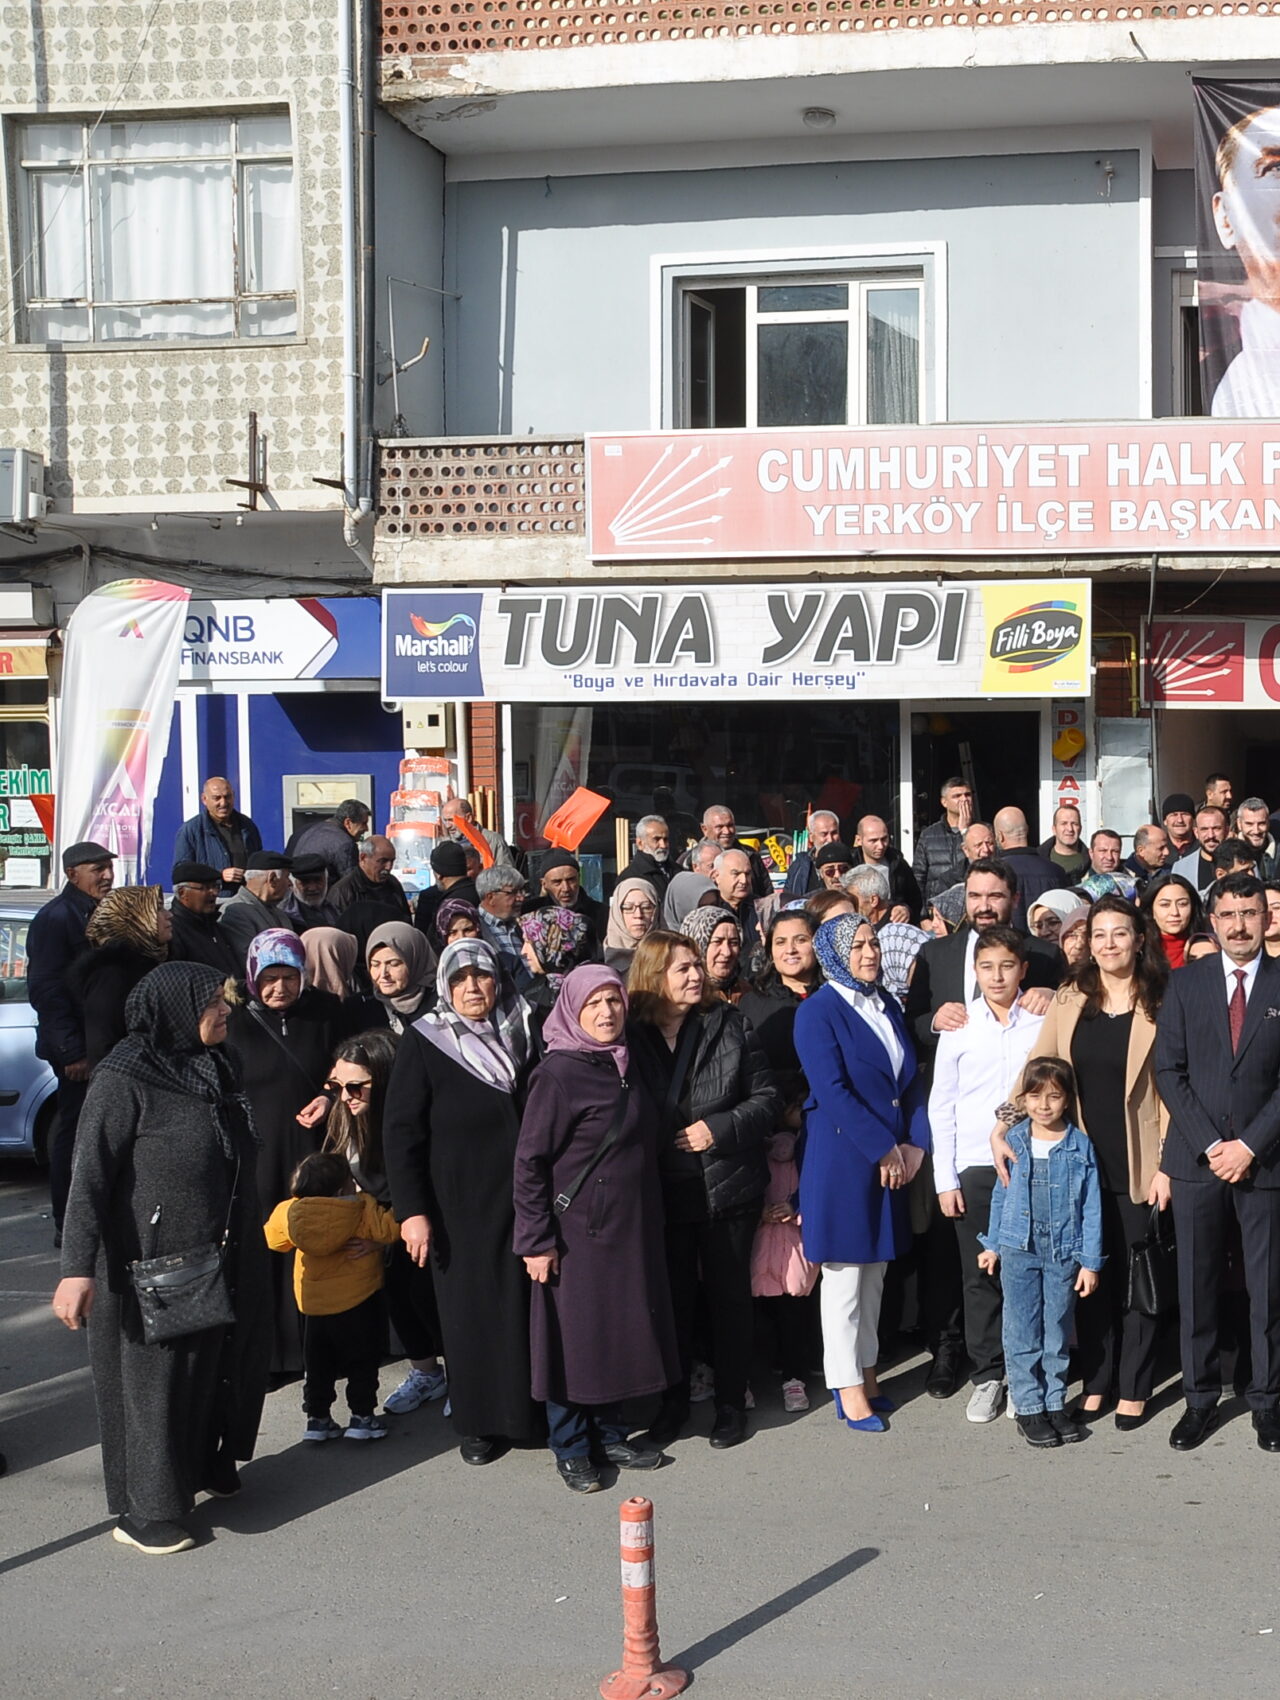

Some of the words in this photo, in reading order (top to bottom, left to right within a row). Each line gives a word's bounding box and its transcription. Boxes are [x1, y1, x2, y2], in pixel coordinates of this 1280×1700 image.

[757, 434, 1089, 493] CUMHURİYET
[1107, 441, 1246, 487] HALK
[803, 495, 983, 536] YERKÖY
[997, 494, 1095, 540] İLÇE
[183, 615, 256, 643] QNB
[498, 594, 715, 667] TUNA
[762, 591, 966, 666] YAPI
[996, 623, 1030, 653] Filli
[1031, 620, 1079, 649] Boya
[181, 648, 284, 665] FINANSBANK
[396, 634, 468, 657] Marshall
[417, 660, 437, 673] let's
[438, 660, 468, 673] colour
[625, 676, 644, 688] ve
[653, 672, 738, 688] Hırdavata
[747, 672, 783, 687] Dair
